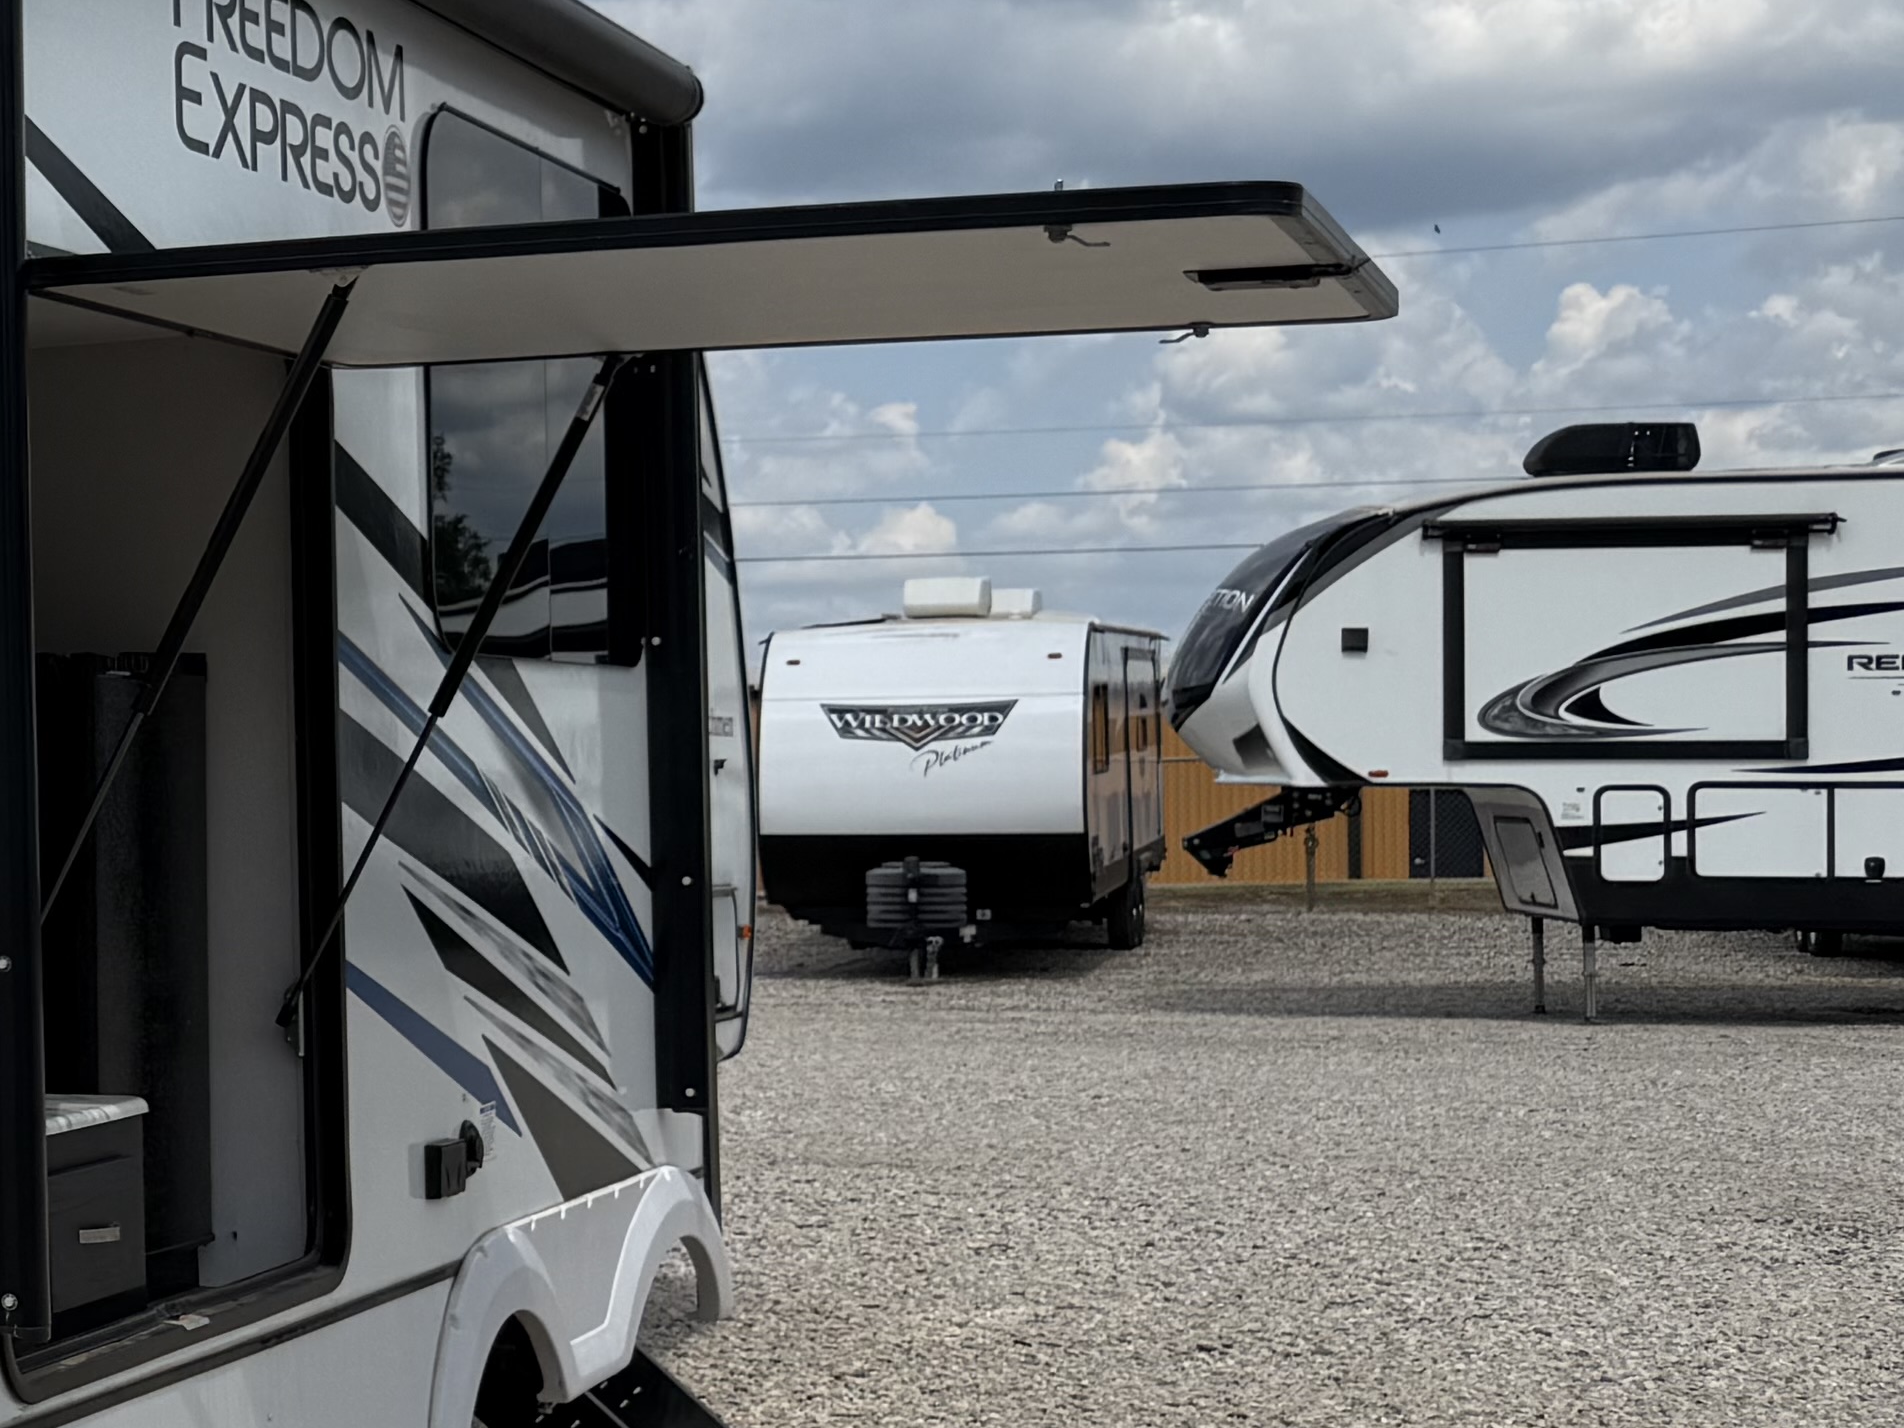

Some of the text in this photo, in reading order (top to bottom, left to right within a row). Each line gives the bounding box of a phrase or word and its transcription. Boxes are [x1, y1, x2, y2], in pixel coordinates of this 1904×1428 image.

[174, 40, 382, 213] EXPRESS
[1847, 653, 1904, 672] RE
[829, 710, 1004, 729] WILDWOOD
